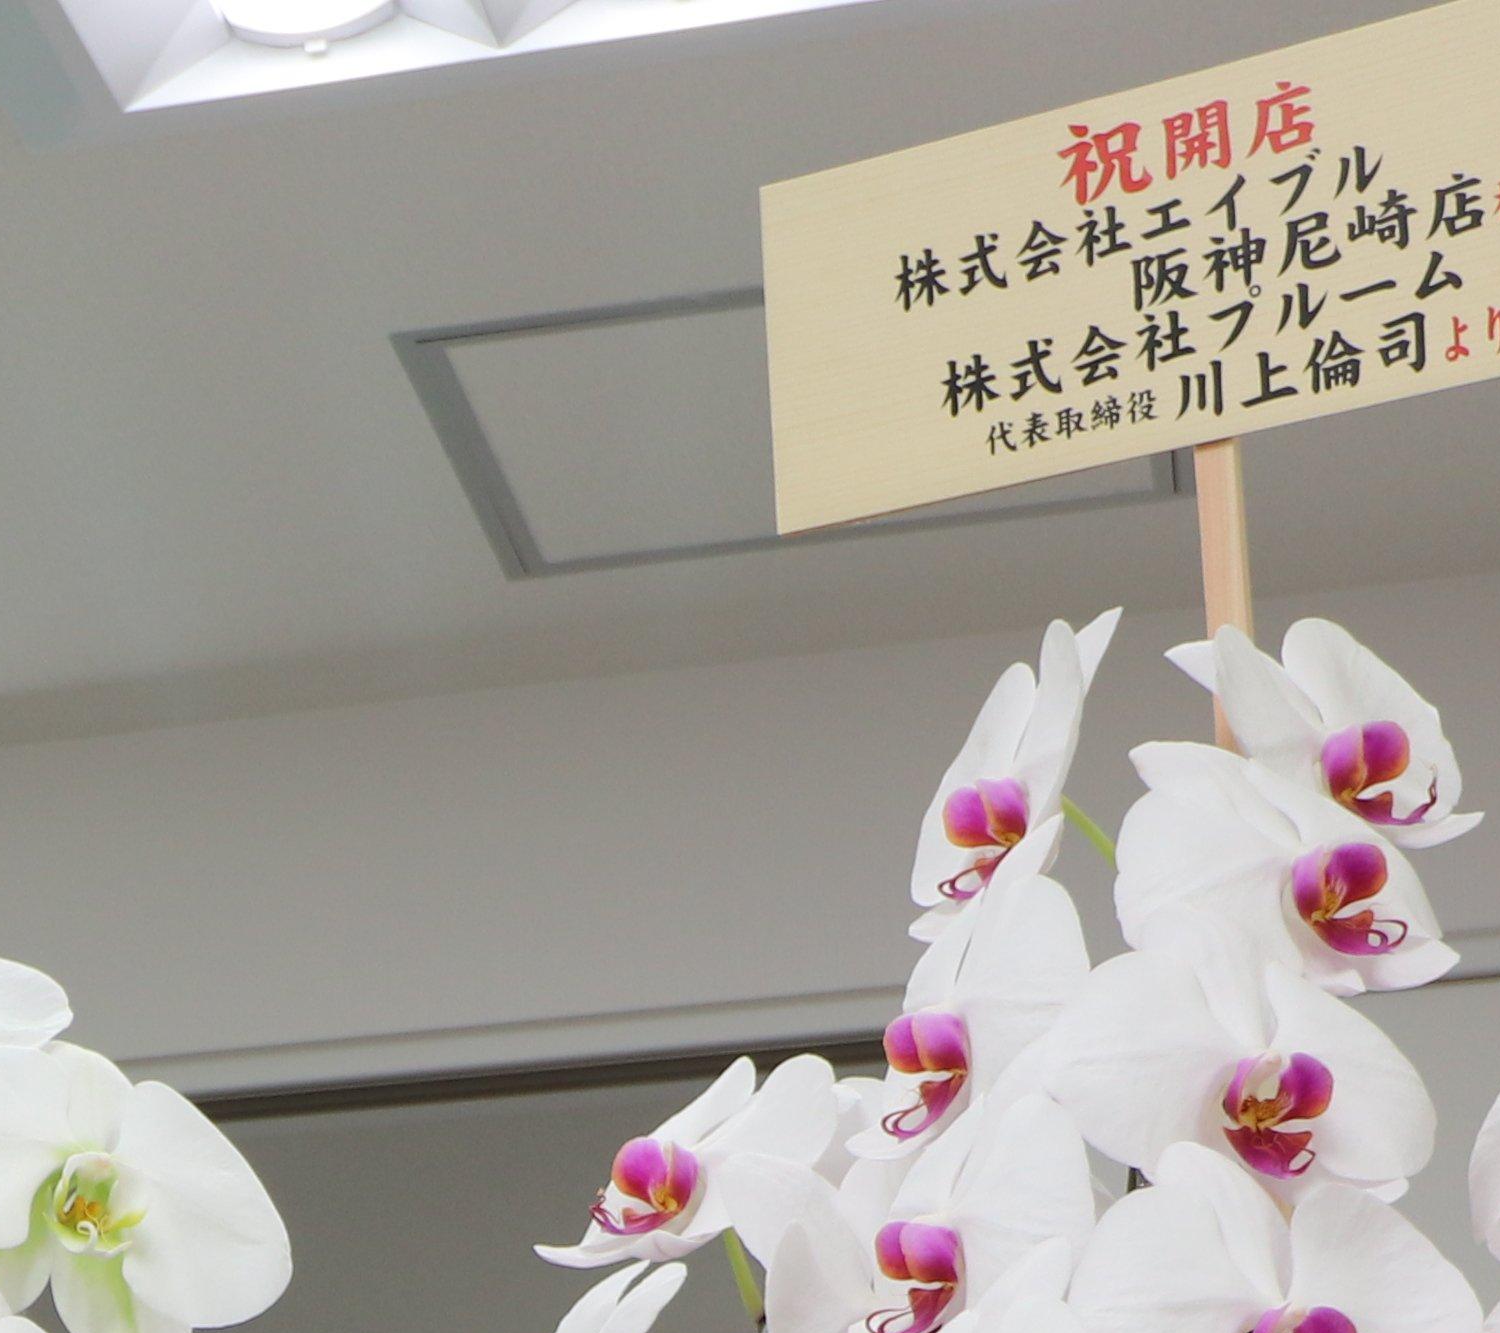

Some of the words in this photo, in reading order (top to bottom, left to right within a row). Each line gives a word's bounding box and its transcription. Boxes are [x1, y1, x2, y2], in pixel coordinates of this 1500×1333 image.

[1055, 79, 1318, 206] 祝開店
[892, 145, 1386, 314] 株式会社エイブル
[985, 389, 1160, 457] 代表取締役
